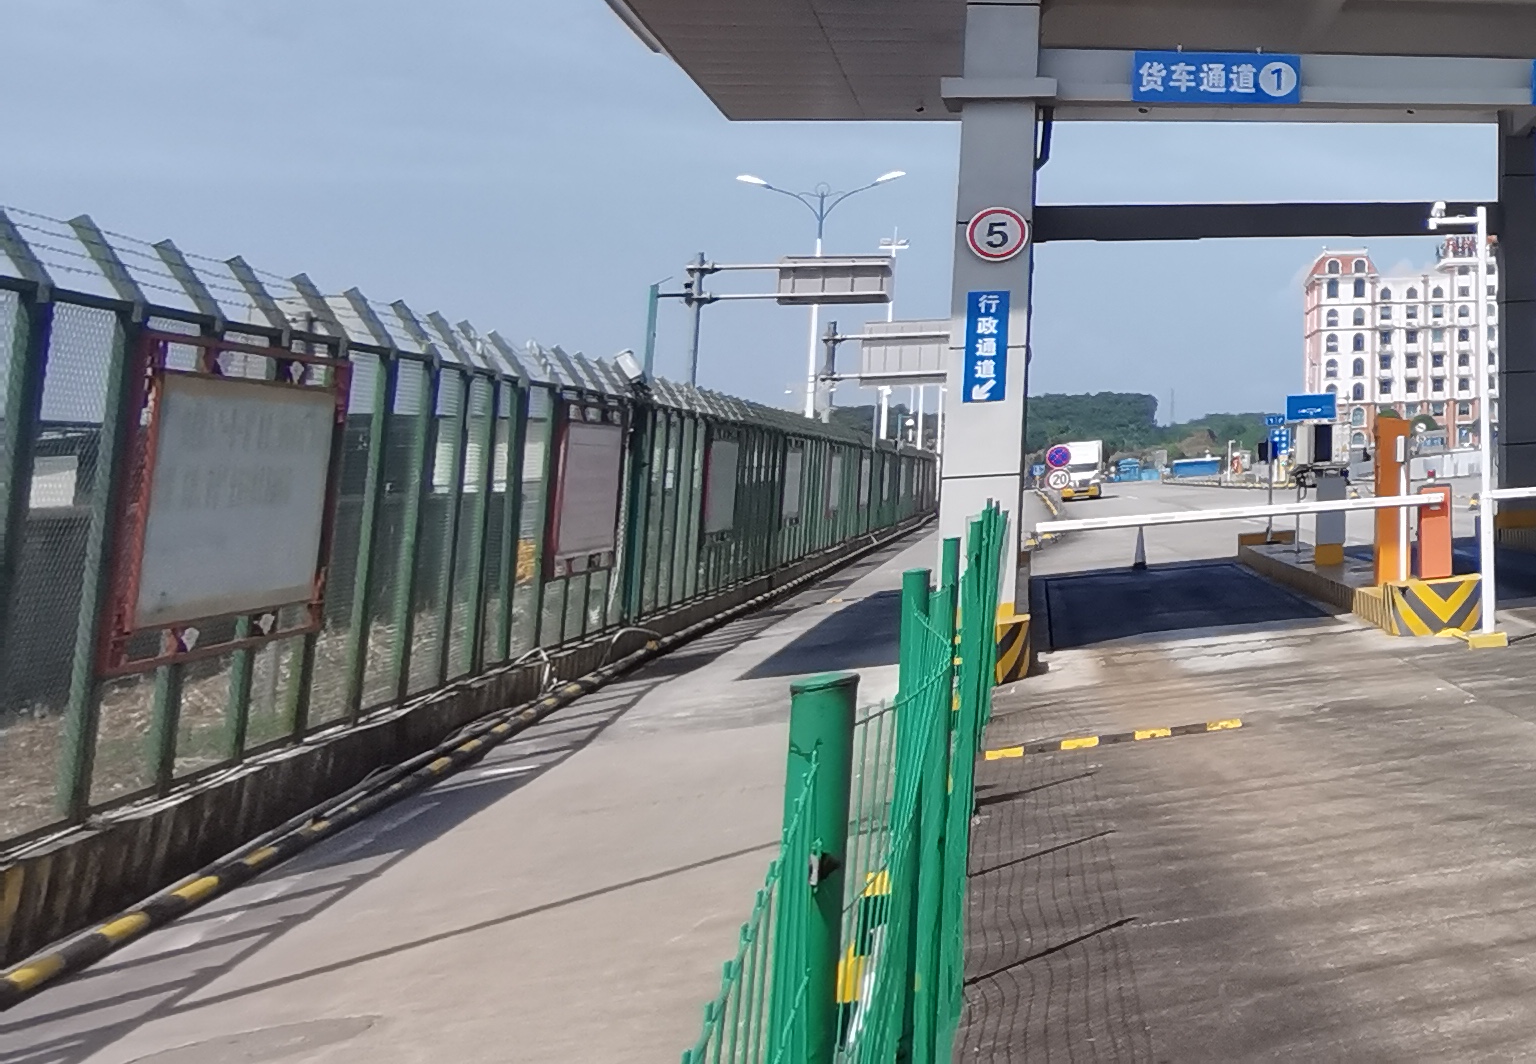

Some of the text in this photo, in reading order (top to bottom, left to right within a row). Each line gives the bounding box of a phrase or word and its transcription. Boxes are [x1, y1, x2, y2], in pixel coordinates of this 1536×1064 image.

[1139, 61, 1256, 94] 货车通道
[986, 222, 1008, 248] 5
[974, 294, 1000, 379] 行政通道
[1052, 473, 1067, 486] 20
